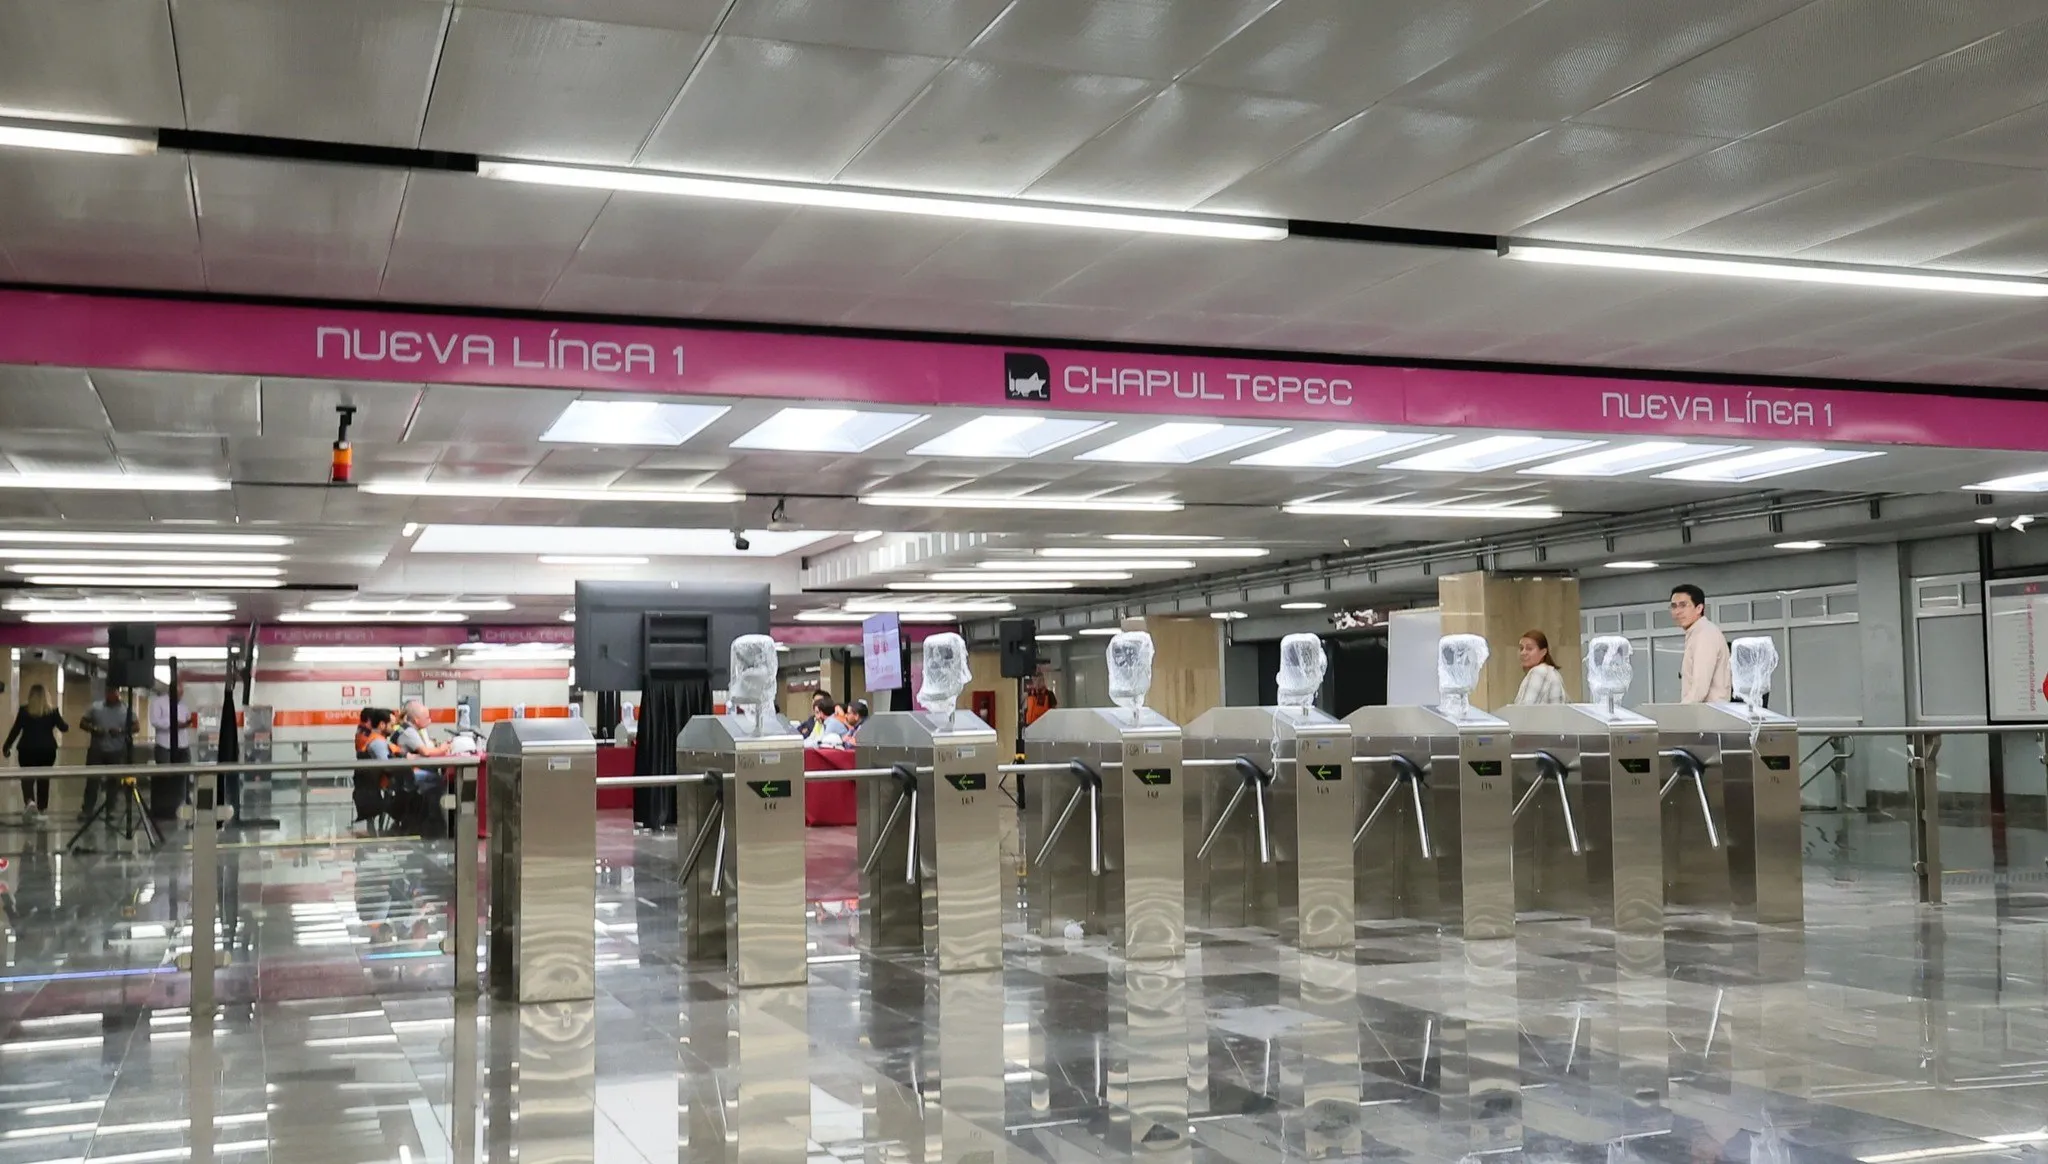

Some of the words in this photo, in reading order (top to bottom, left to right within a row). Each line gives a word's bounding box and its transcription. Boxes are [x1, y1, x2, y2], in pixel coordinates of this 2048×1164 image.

[316, 326, 495, 367] NUEVA
[513, 328, 655, 375] LÍNEA
[672, 345, 684, 376] 1
[1063, 365, 1353, 407] CHAPULTEPEC
[1602, 392, 1713, 422] NUEVA
[1724, 391, 1814, 426] LÍNEA
[1824, 402, 1833, 427] 1
